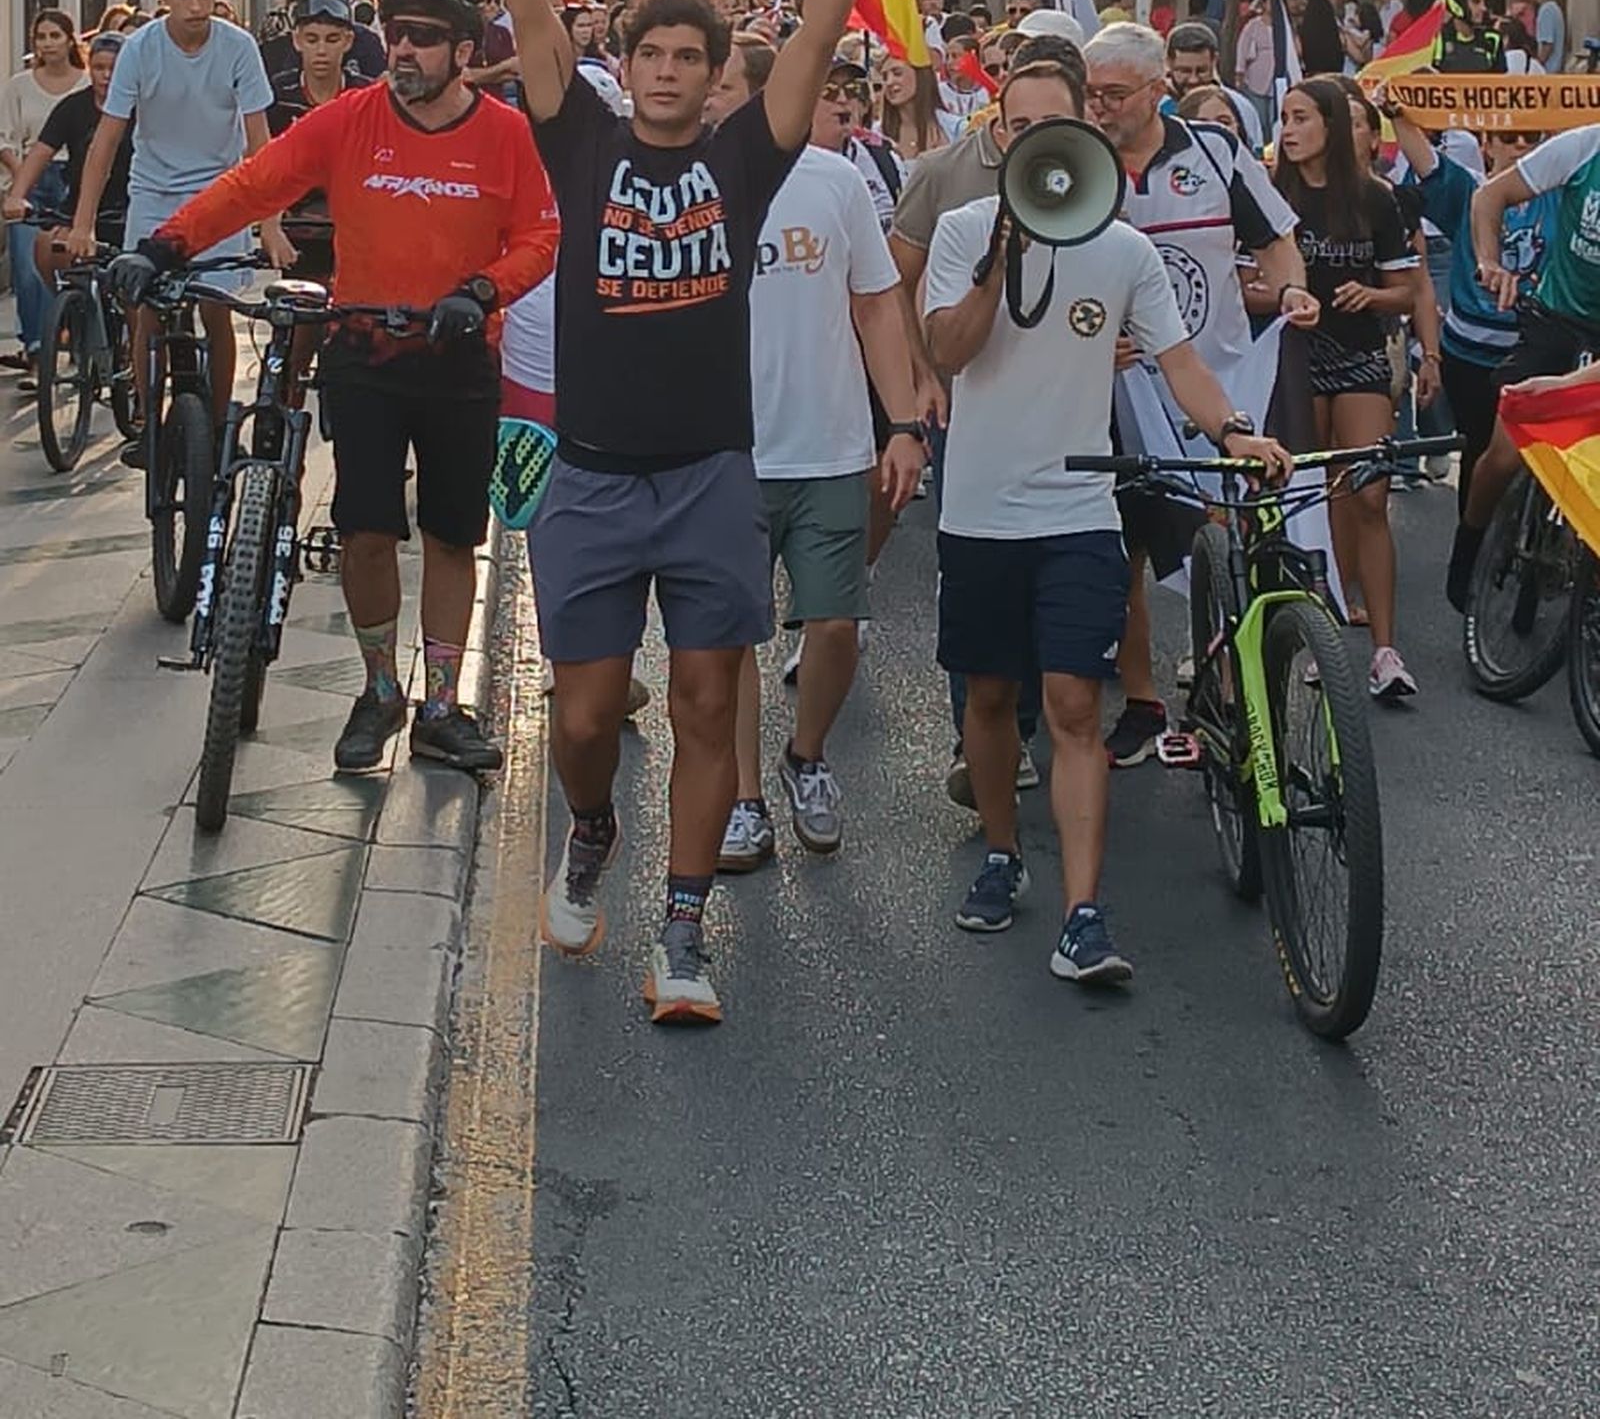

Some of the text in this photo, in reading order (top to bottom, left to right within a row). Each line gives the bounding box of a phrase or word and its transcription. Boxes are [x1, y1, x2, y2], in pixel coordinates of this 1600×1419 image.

[1463, 85, 1551, 110] HOCKEY
[603, 207, 632, 230] NO
[664, 203, 727, 240] VENDE
[599, 222, 732, 279] CEUTA
[597, 273, 730, 299] SE DEFIENDE
